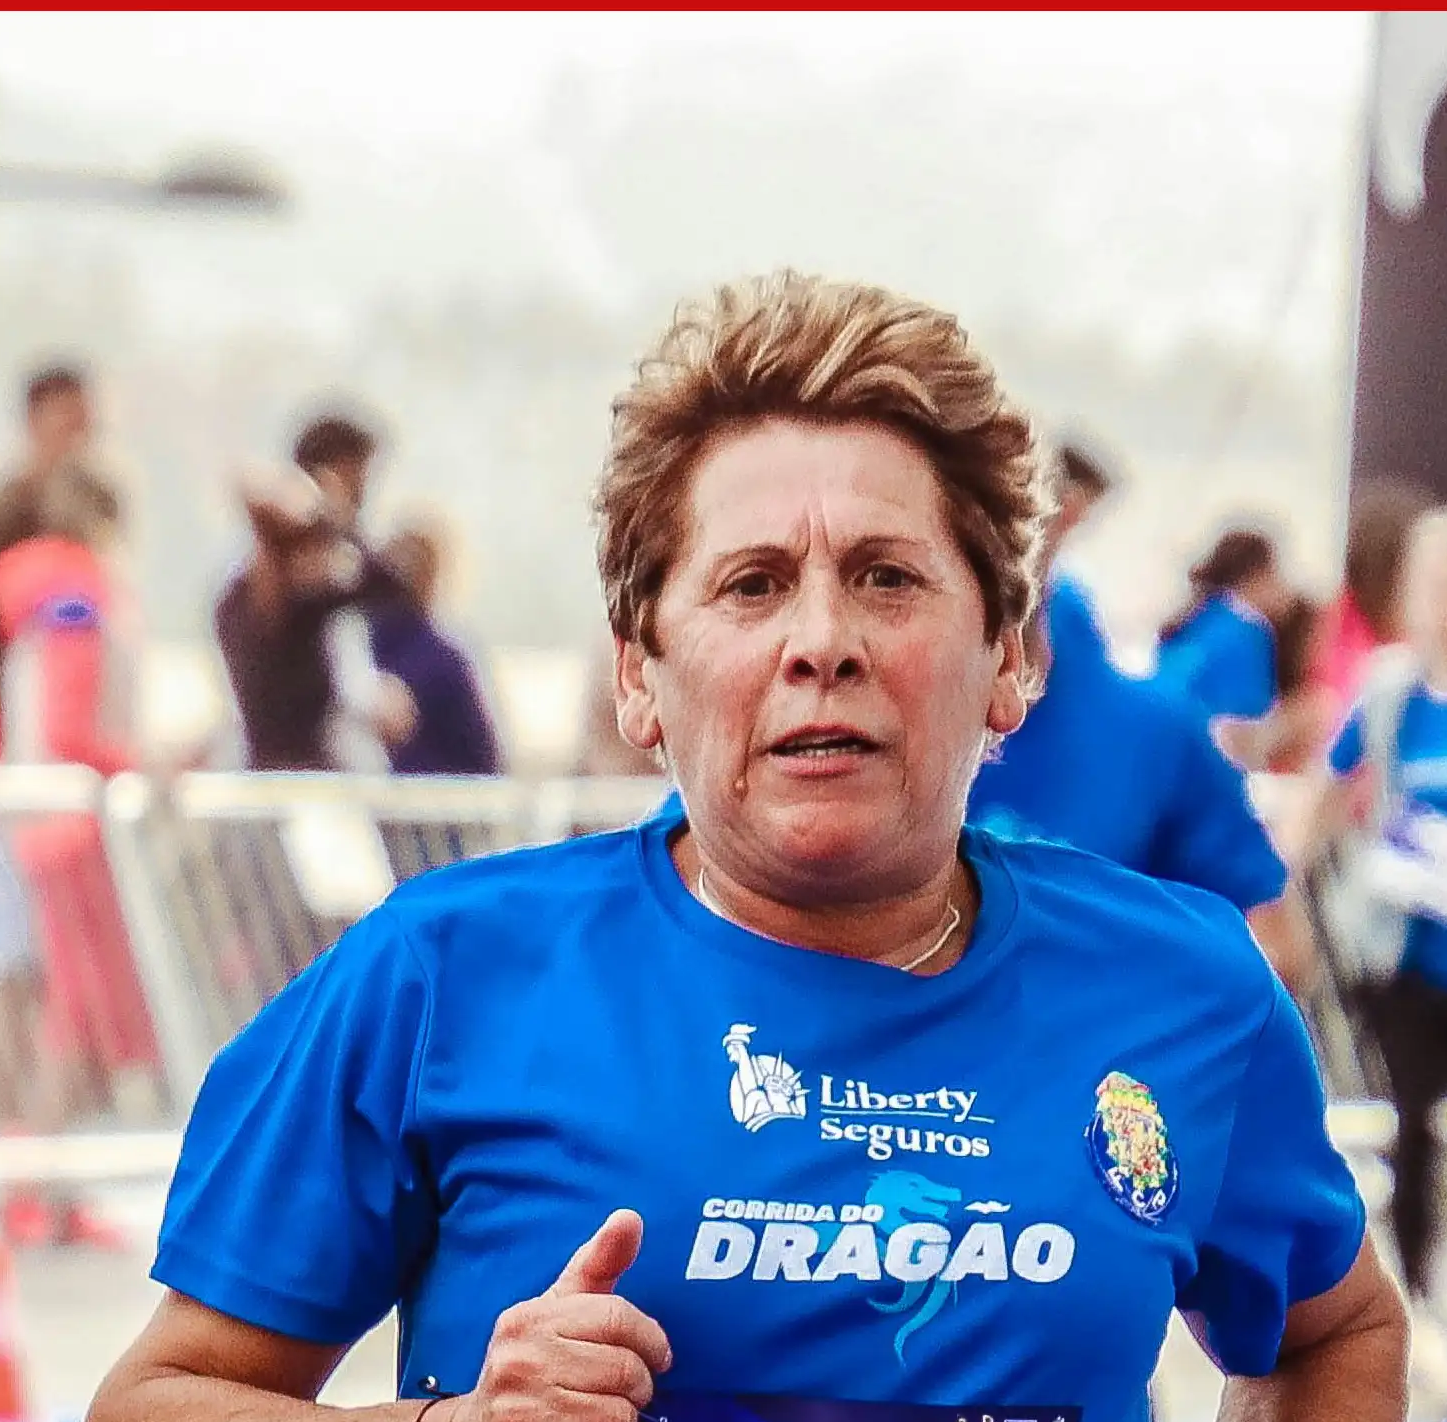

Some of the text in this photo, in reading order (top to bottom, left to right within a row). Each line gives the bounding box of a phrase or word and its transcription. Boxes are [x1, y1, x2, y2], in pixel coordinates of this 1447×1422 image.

[820, 1073, 978, 1123] Liberty
[819, 1117, 991, 1161] Seguros
[702, 1199, 884, 1223] CORRIDA DO
[685, 1200, 1076, 1283] DRAGÃO
